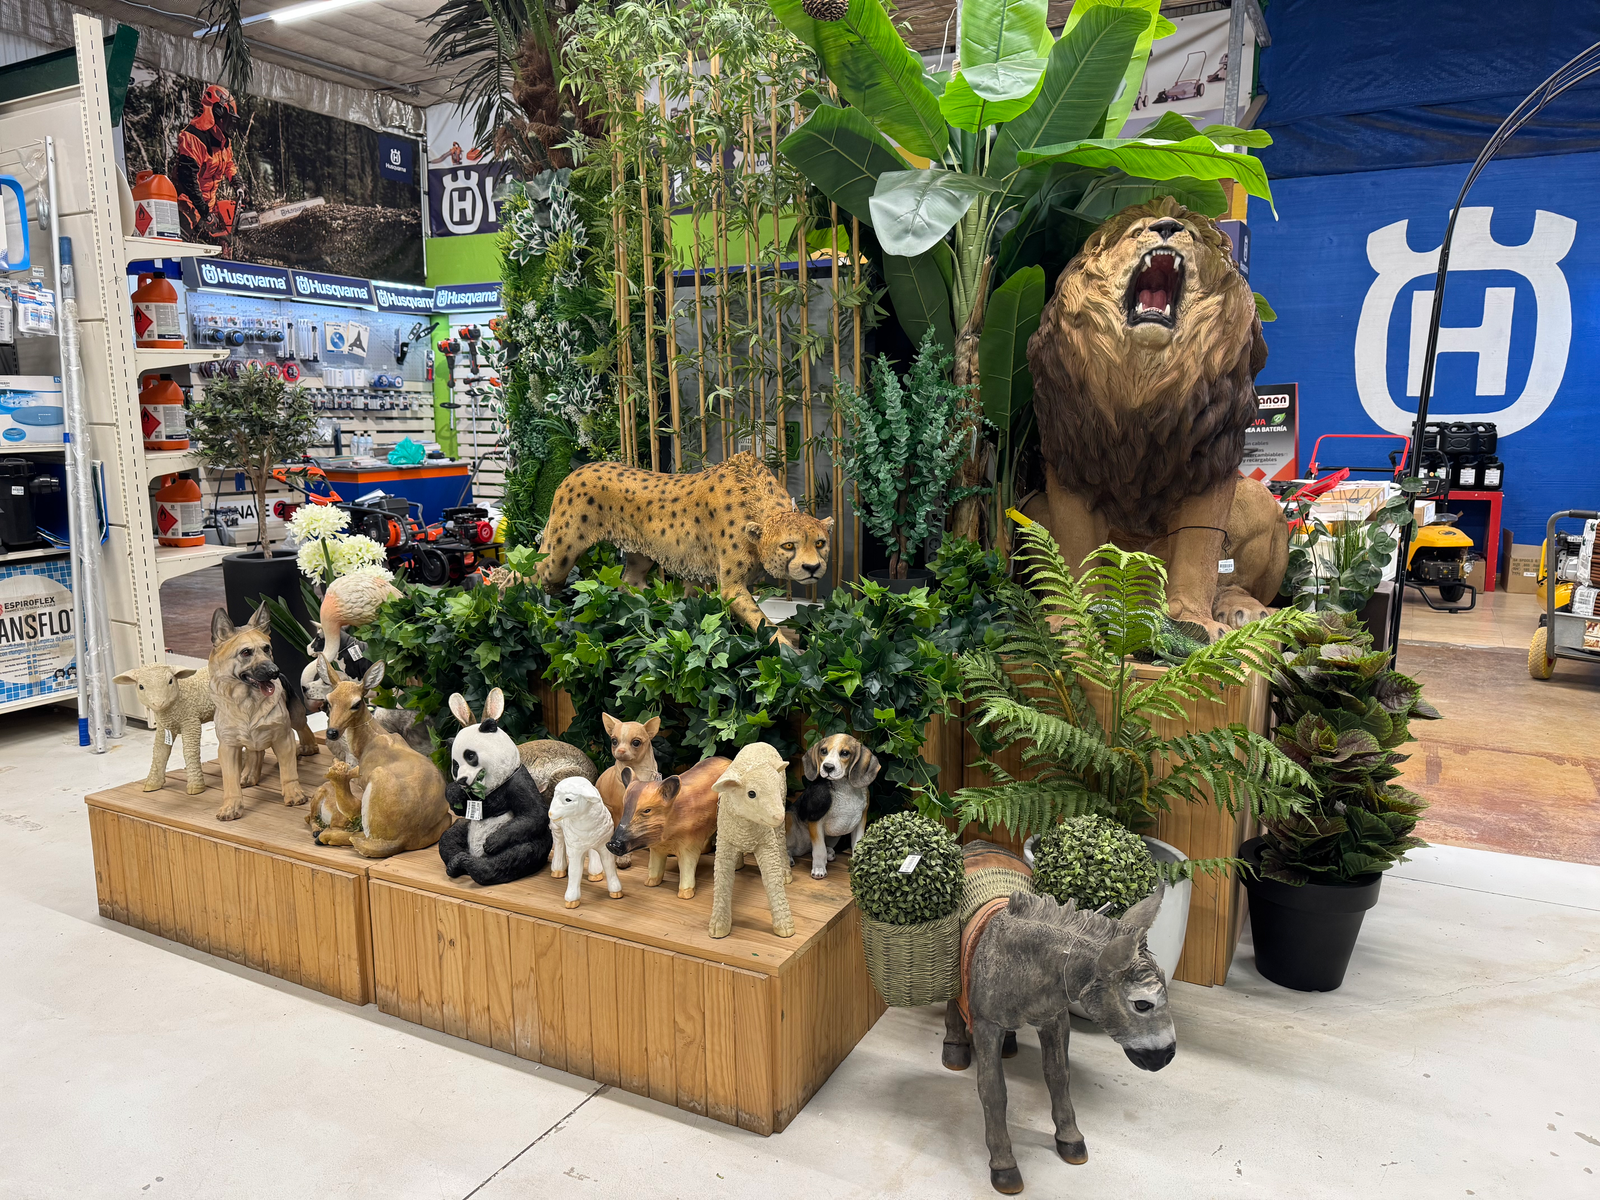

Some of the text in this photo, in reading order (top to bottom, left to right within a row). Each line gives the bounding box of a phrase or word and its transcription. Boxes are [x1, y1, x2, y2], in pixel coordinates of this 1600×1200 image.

[385, 162, 407, 173] Husqvarna
[217, 267, 286, 290] Husqvarna
[308, 279, 368, 300] Husqvarna
[447, 290, 498, 306] Husqvarna
[1259, 396, 1287, 404] anon
[1261, 424, 1288, 432] BATERÍA
[276, 502, 285, 517] 2
[4, 596, 55, 610] ESPIROFLEX
[0, 608, 73, 644] ANSFLO
